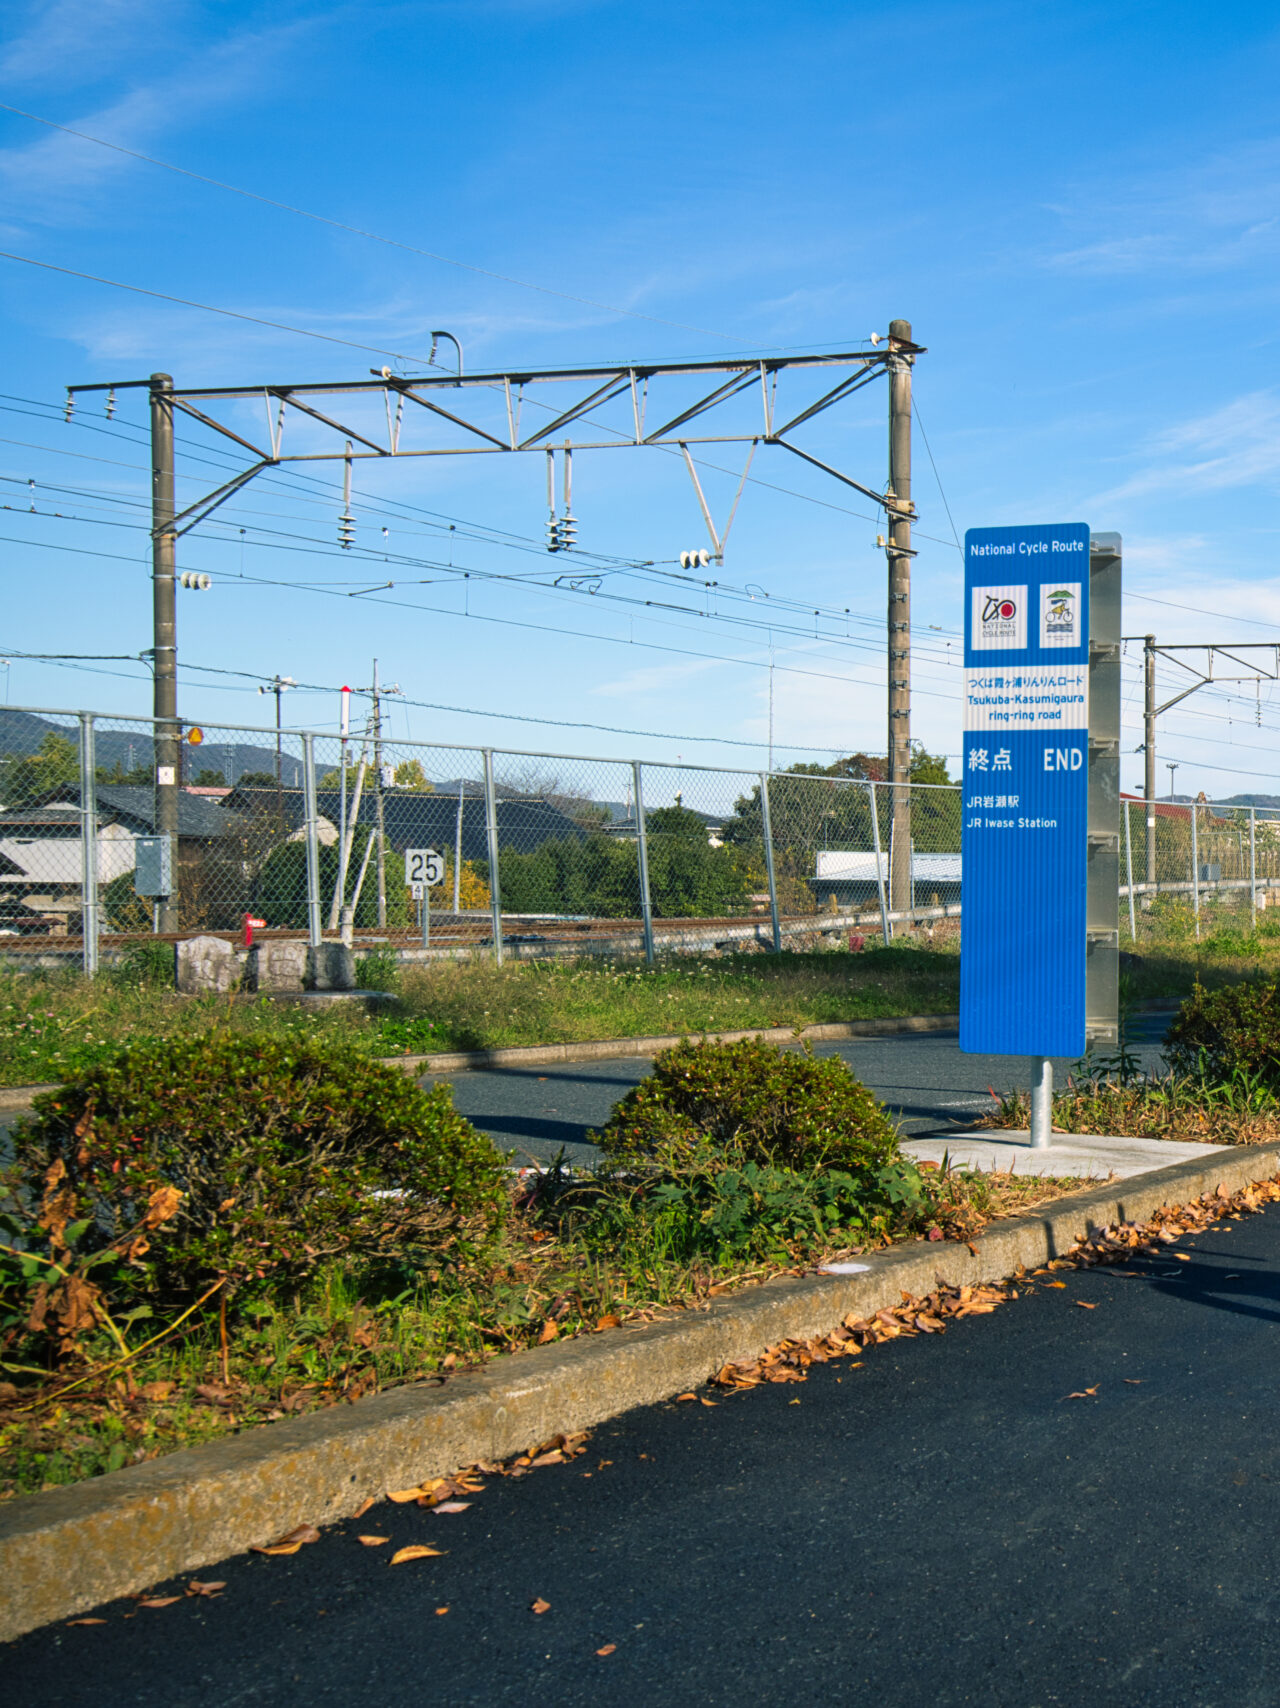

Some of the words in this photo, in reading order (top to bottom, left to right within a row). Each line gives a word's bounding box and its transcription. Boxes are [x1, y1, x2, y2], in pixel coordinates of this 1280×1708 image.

[970, 543, 1015, 556] National
[1019, 541, 1048, 556] Cycle
[1051, 539, 1084, 553] Route
[968, 675, 1084, 689] つくば霞ヶ浦りんりんロード
[967, 693, 1085, 706] Tsukuba-Kasumigaura
[988, 710, 1035, 722] ring-ring
[1038, 709, 1062, 720] road
[968, 747, 1013, 772] 終点
[1043, 748, 1083, 771] END
[966, 795, 1020, 809] JR岩瀬駅
[966, 818, 982, 828] JR
[985, 818, 1015, 828] Iwase
[1018, 817, 1057, 828] Station
[411, 854, 438, 881] 25
